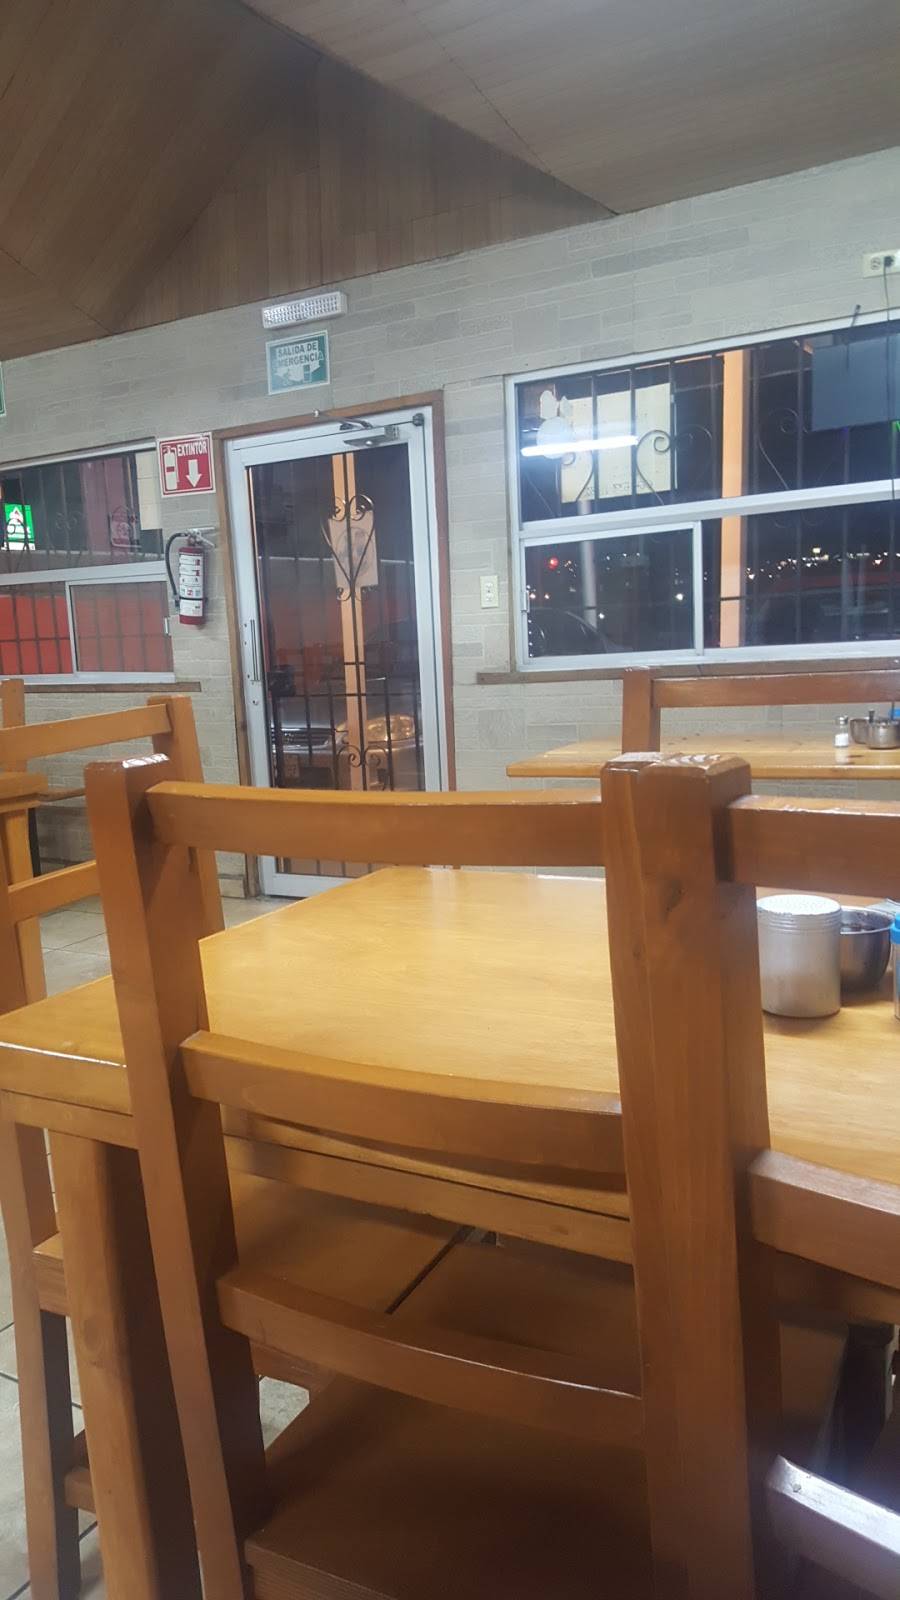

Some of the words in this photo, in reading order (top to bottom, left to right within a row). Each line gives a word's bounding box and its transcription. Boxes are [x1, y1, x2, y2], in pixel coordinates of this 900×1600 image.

[278, 344, 305, 357] SALIDA
[307, 342, 317, 351] DE
[272, 350, 324, 367] MERGENCIA
[177, 440, 208, 457] EXTINTOR
